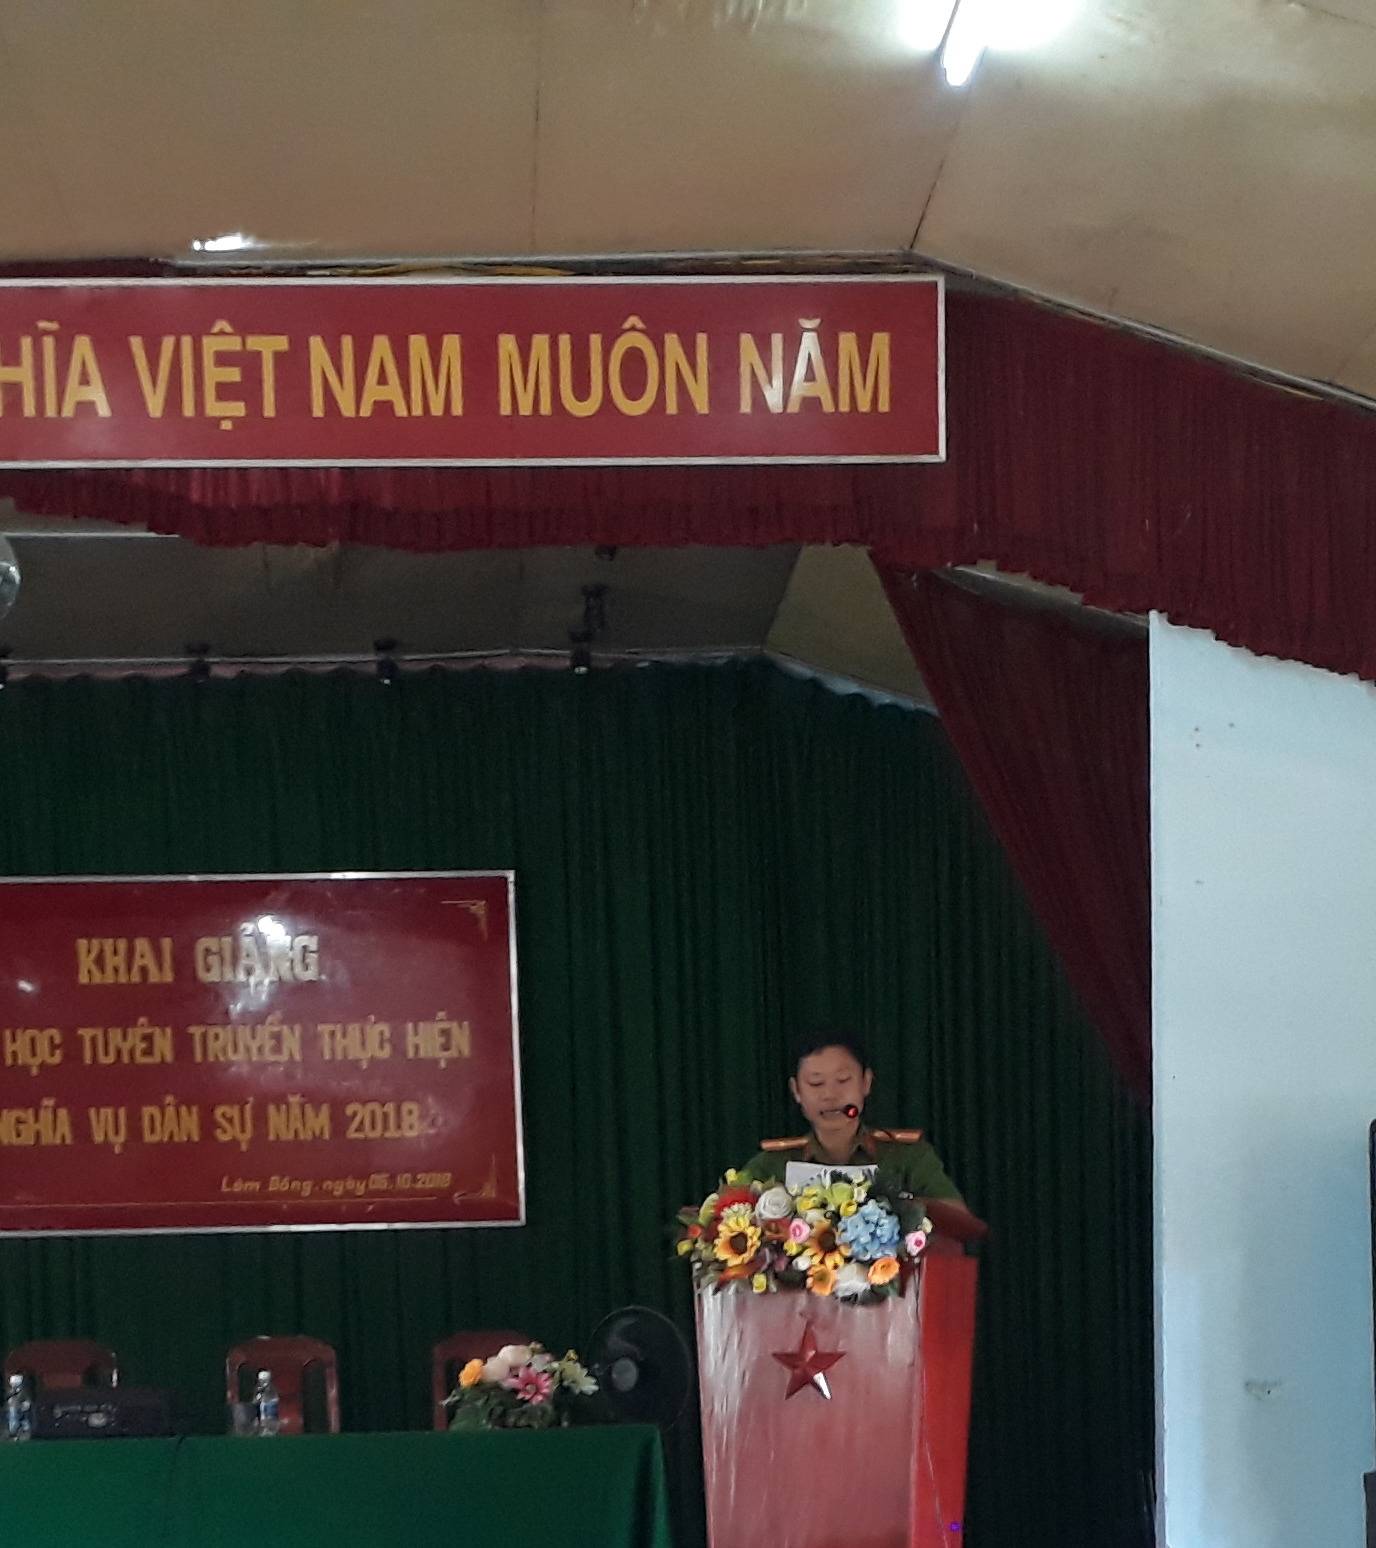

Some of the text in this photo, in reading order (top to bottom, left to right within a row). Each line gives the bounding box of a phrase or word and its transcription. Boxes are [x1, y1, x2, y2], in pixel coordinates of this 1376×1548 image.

[130, 318, 289, 430] VIỆT
[309, 332, 464, 418] NAM
[498, 316, 710, 418] MUÔN
[738, 318, 891, 416] NĂM
[76, 920, 319, 985] KHAI GIẢNG
[3, 1027, 63, 1076] HỌC
[77, 1016, 174, 1065] TUYÊN
[317, 1014, 391, 1070] THỰC
[406, 1011, 471, 1069] HIỆN
[88, 1105, 126, 1154] VỤ
[141, 1095, 201, 1143] DÂN
[214, 1097, 255, 1151] SỰ
[267, 1093, 331, 1141] NĂM
[345, 1101, 420, 1139] 2018
